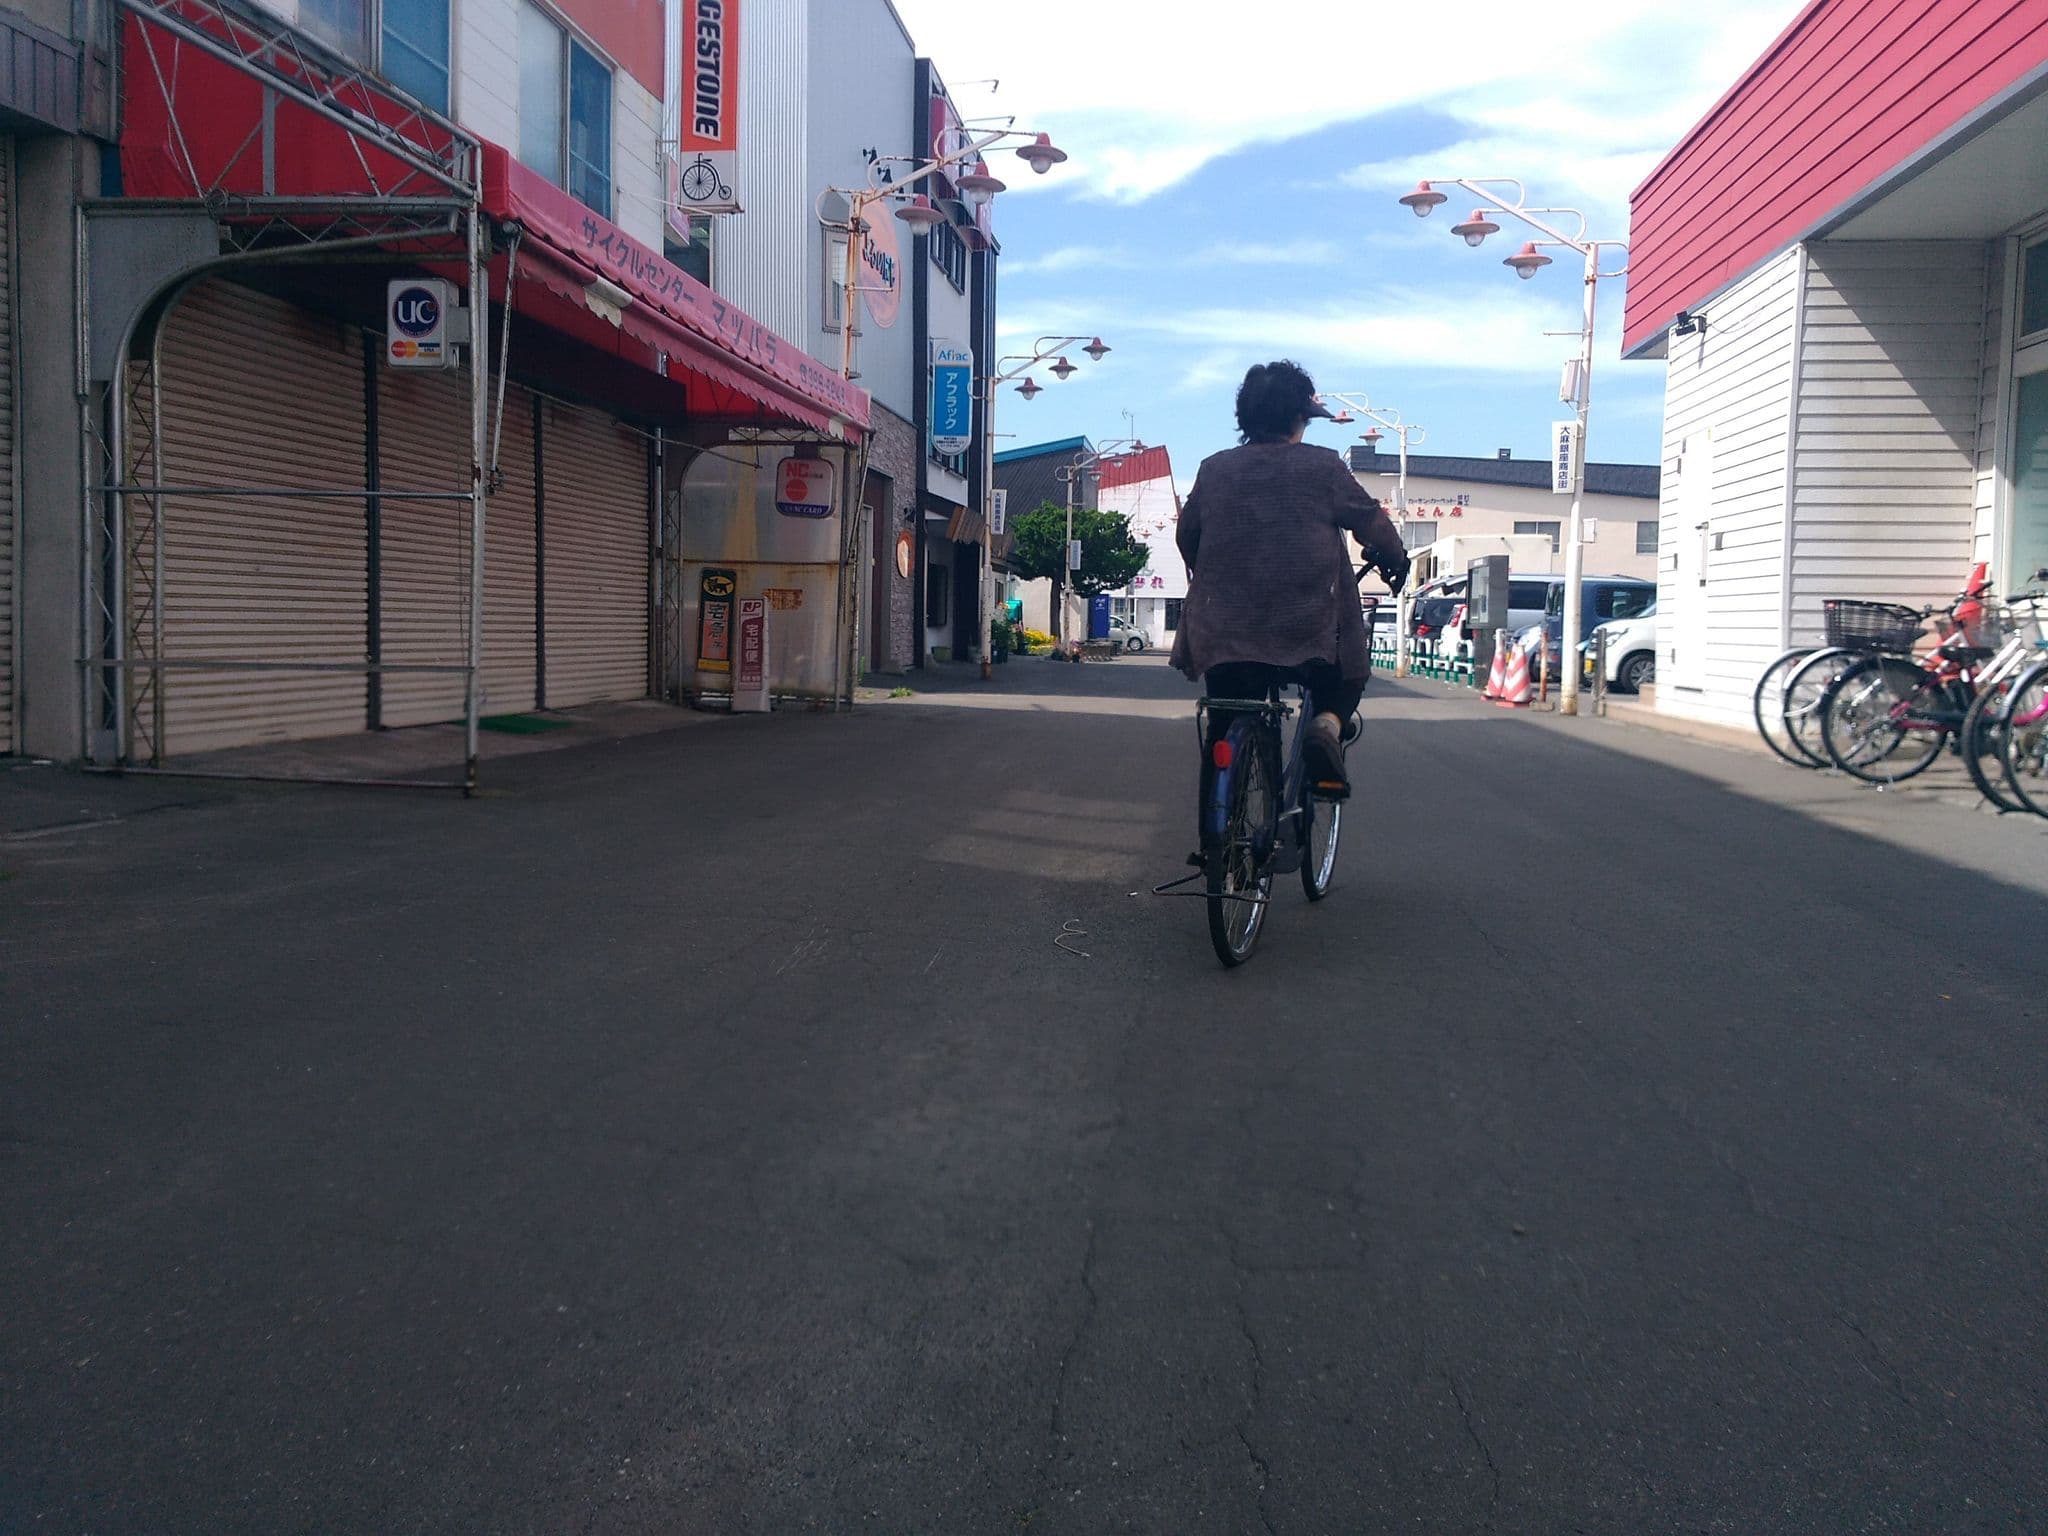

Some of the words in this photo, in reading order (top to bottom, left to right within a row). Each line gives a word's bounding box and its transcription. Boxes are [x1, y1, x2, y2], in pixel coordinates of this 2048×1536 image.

[696, 0, 721, 138] GESTONE
[583, 215, 696, 303] サイクルセンター
[712, 300, 777, 365] マツバラ
[938, 349, 968, 361] Aflac
[945, 372, 958, 430] アフラック
[1558, 426, 1570, 489] 大麻銀座商店街
